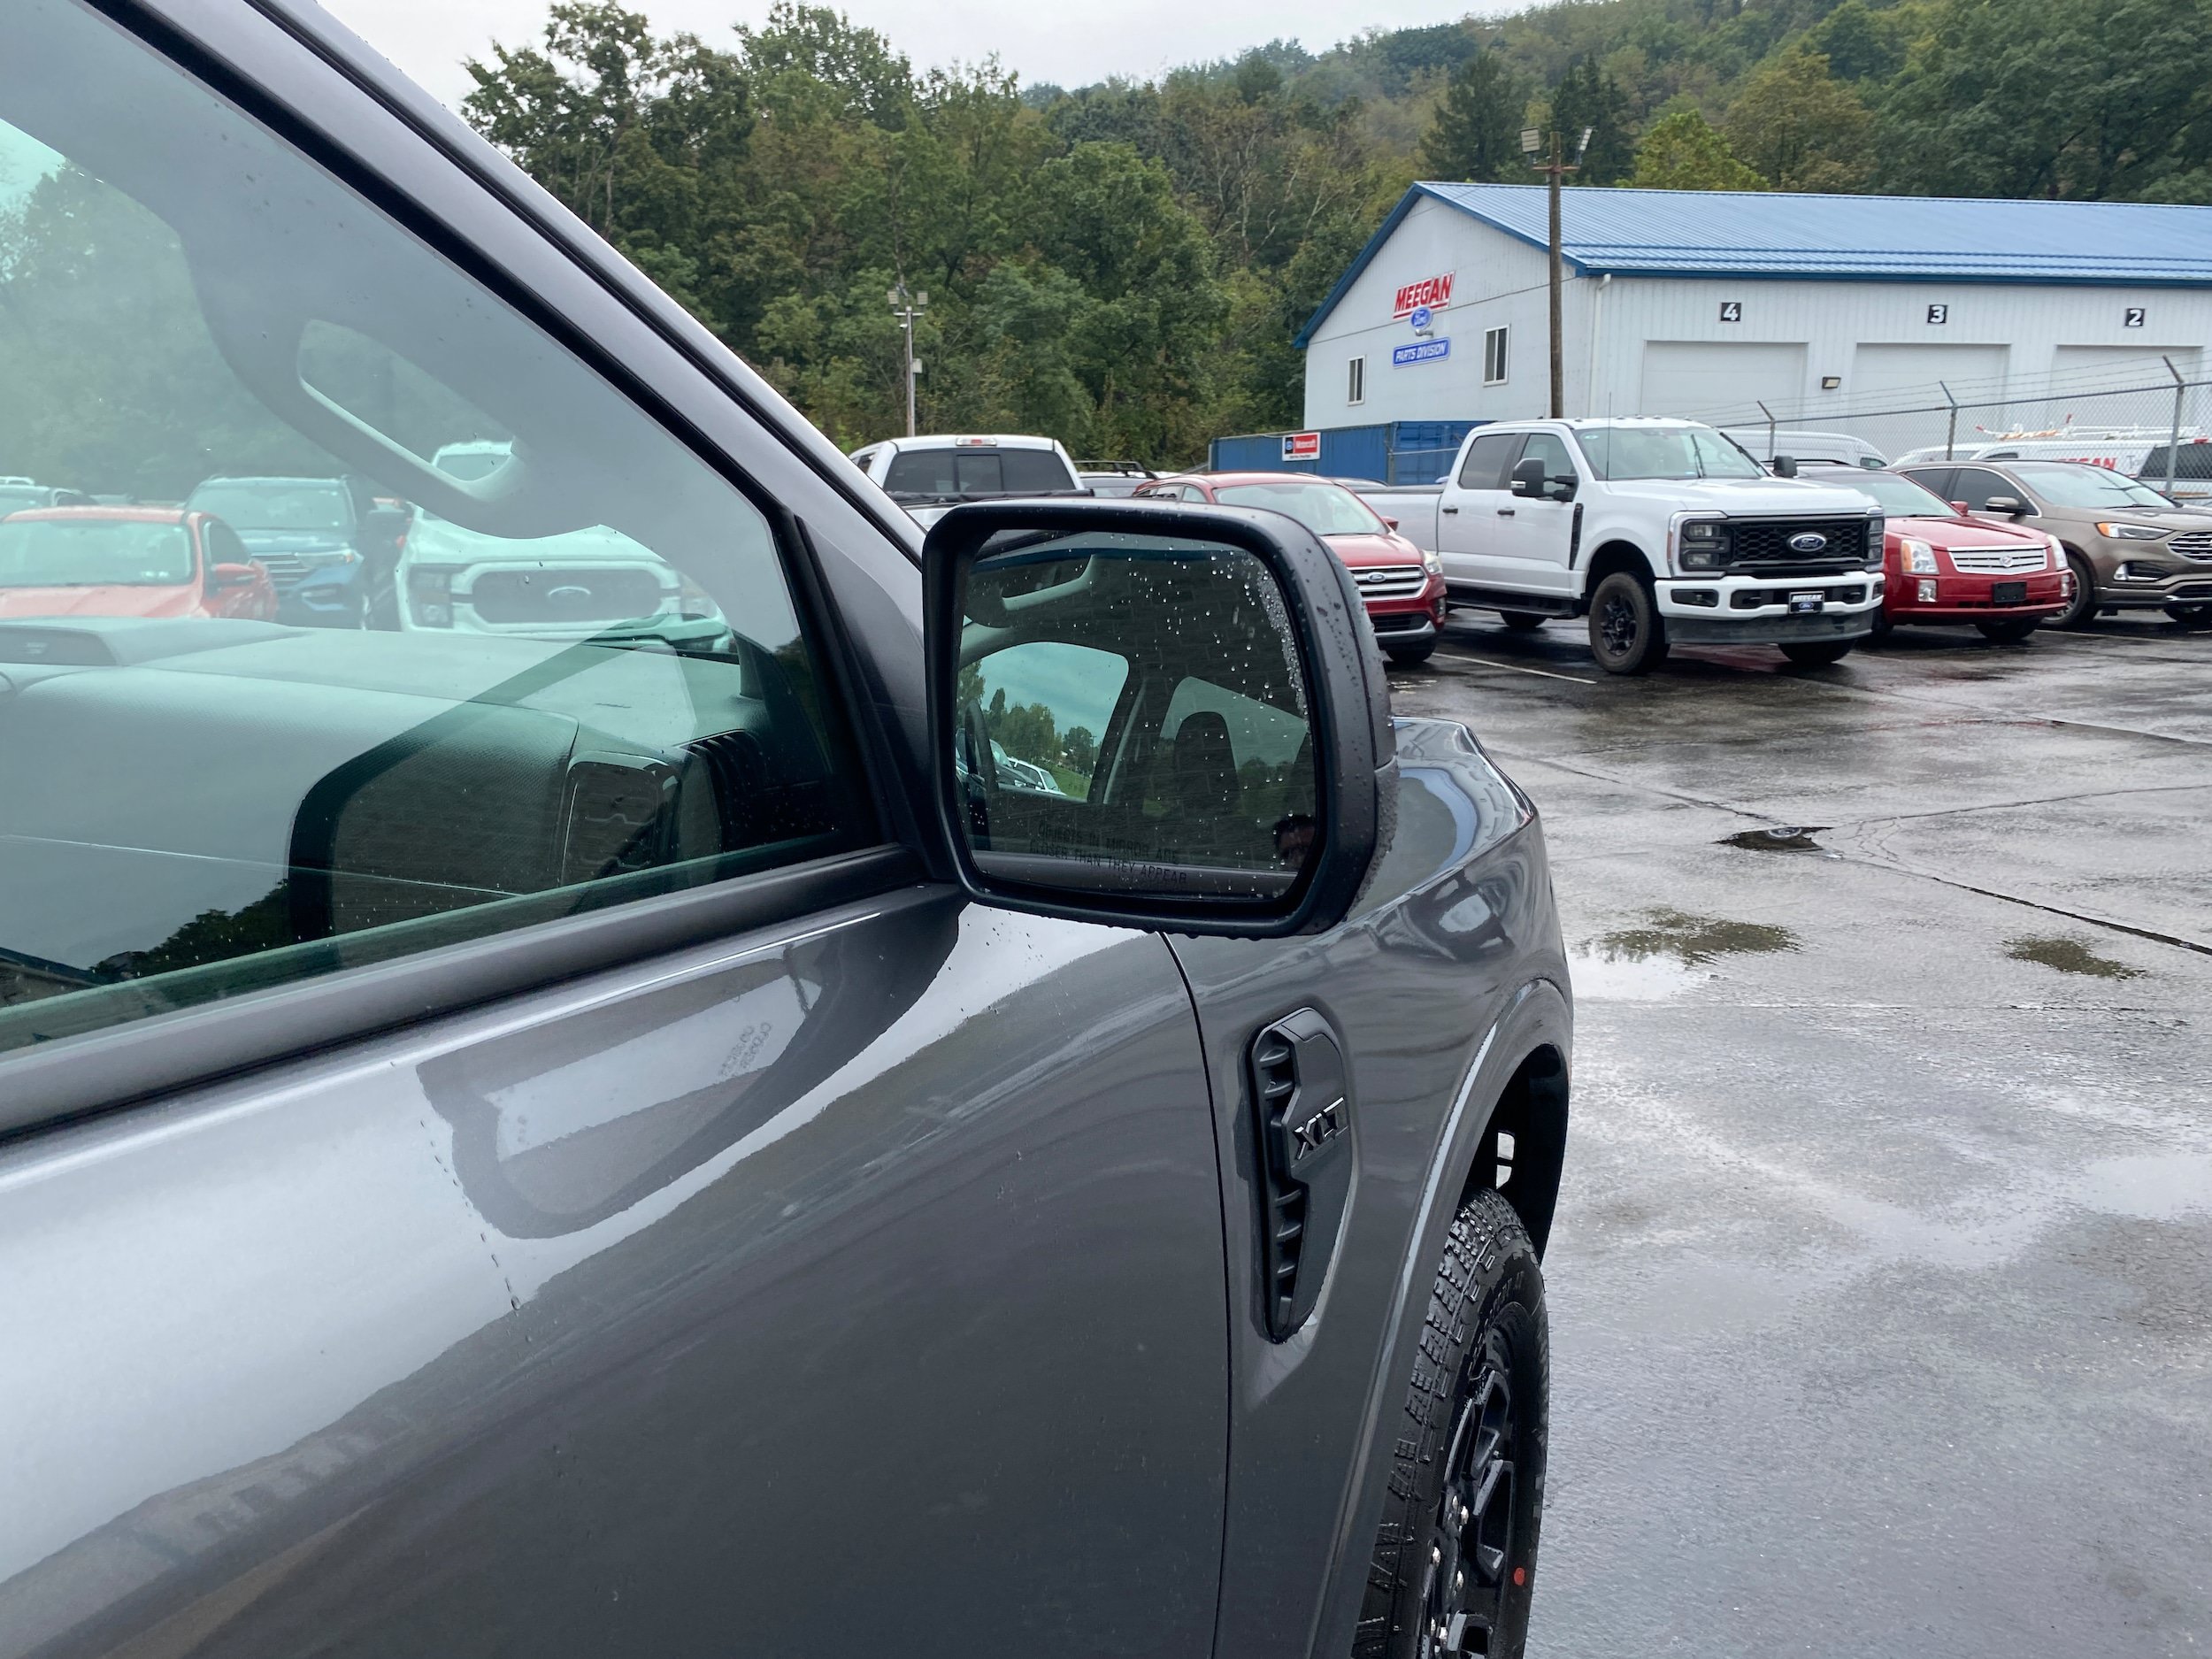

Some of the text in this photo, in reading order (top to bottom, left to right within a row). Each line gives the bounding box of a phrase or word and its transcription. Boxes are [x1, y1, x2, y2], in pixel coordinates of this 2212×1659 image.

[1394, 273, 1454, 312] MEEGAN
[1723, 303, 1739, 321] 4
[1930, 305, 1946, 323] 3
[2128, 309, 2142, 326] 2
[1395, 342, 1448, 363] PARTS DIVISION
[1107, 856, 1136, 874] THEY
[1141, 864, 1187, 884] APPEAR
[1294, 1095, 1346, 1160] XLT
